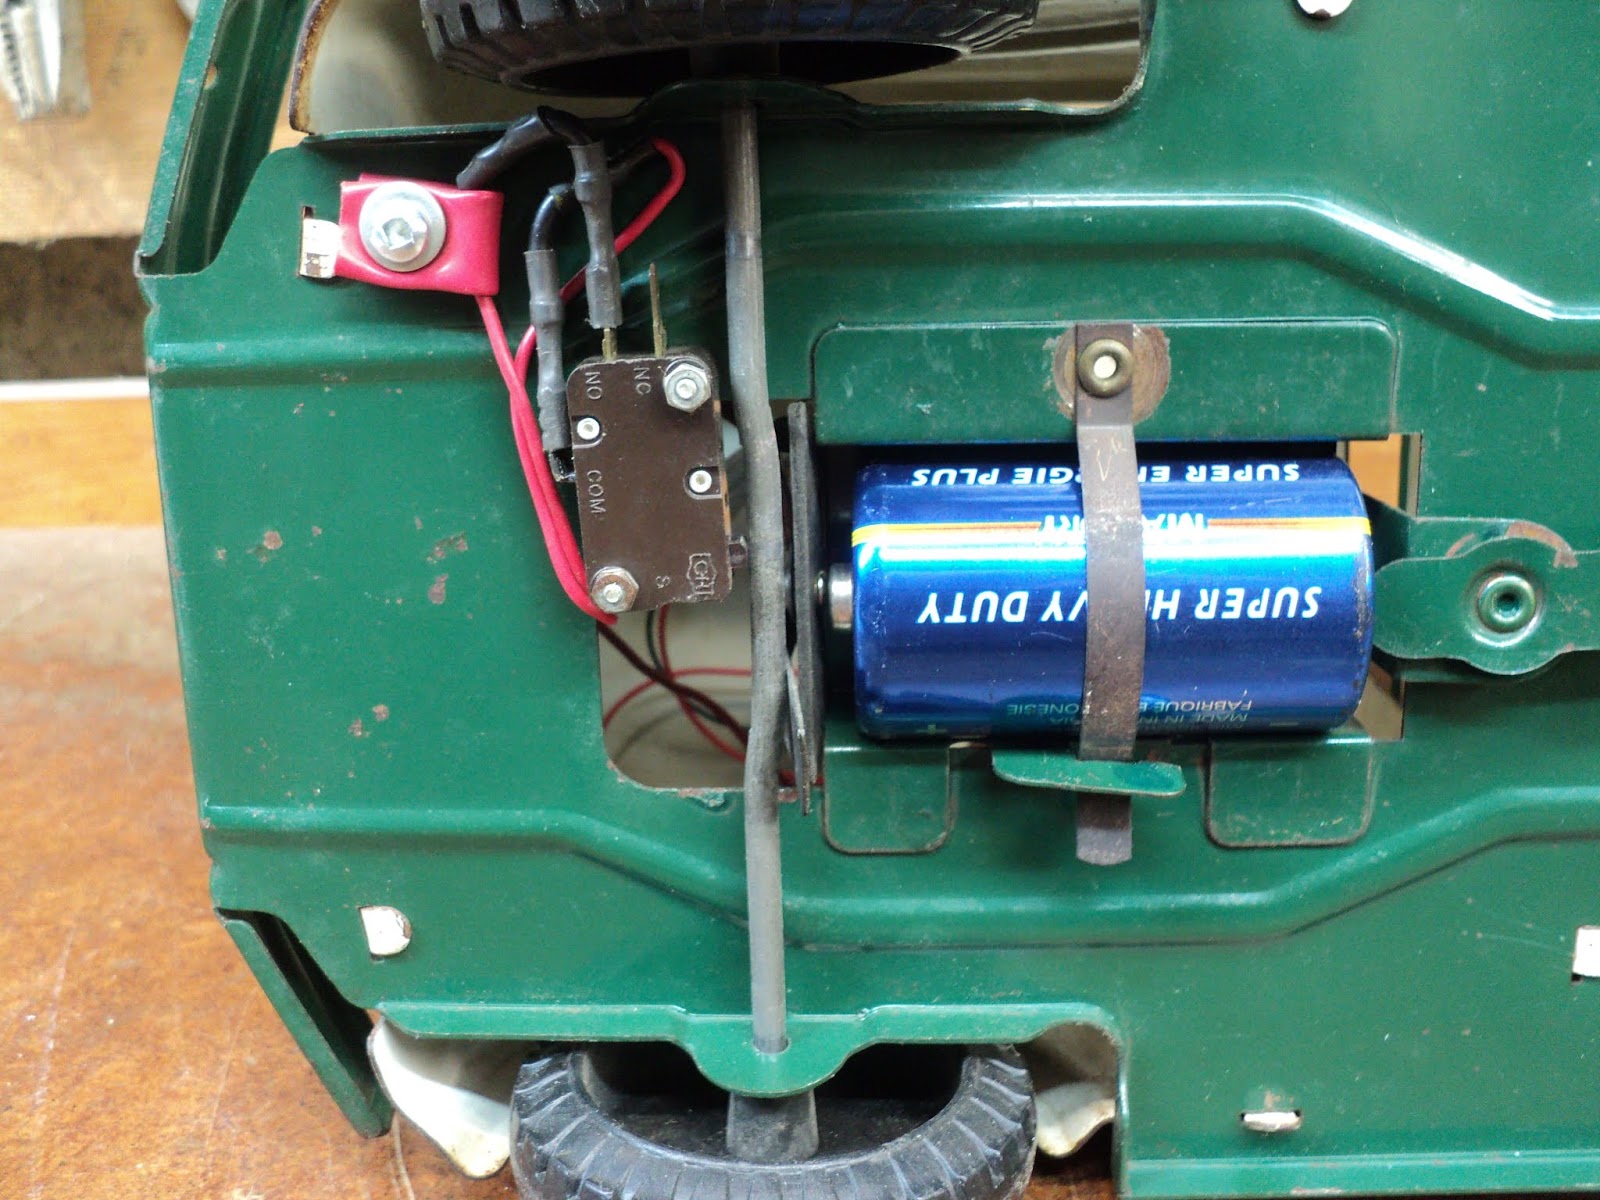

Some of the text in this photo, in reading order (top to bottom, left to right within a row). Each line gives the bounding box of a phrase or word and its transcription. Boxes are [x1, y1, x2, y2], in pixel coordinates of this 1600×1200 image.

[585, 371, 603, 400] NO
[634, 367, 651, 395] NC
[911, 464, 1300, 486] SUPER EGIE PLUS
[587, 470, 606, 513] COM
[915, 586, 1322, 624] SUPER HVY DUTY
[1007, 702, 1080, 716] ONÉSIE
[1154, 700, 1253, 713] FABRIQUE
[1191, 712, 1248, 723] MADE
[1166, 714, 1184, 724] IN
